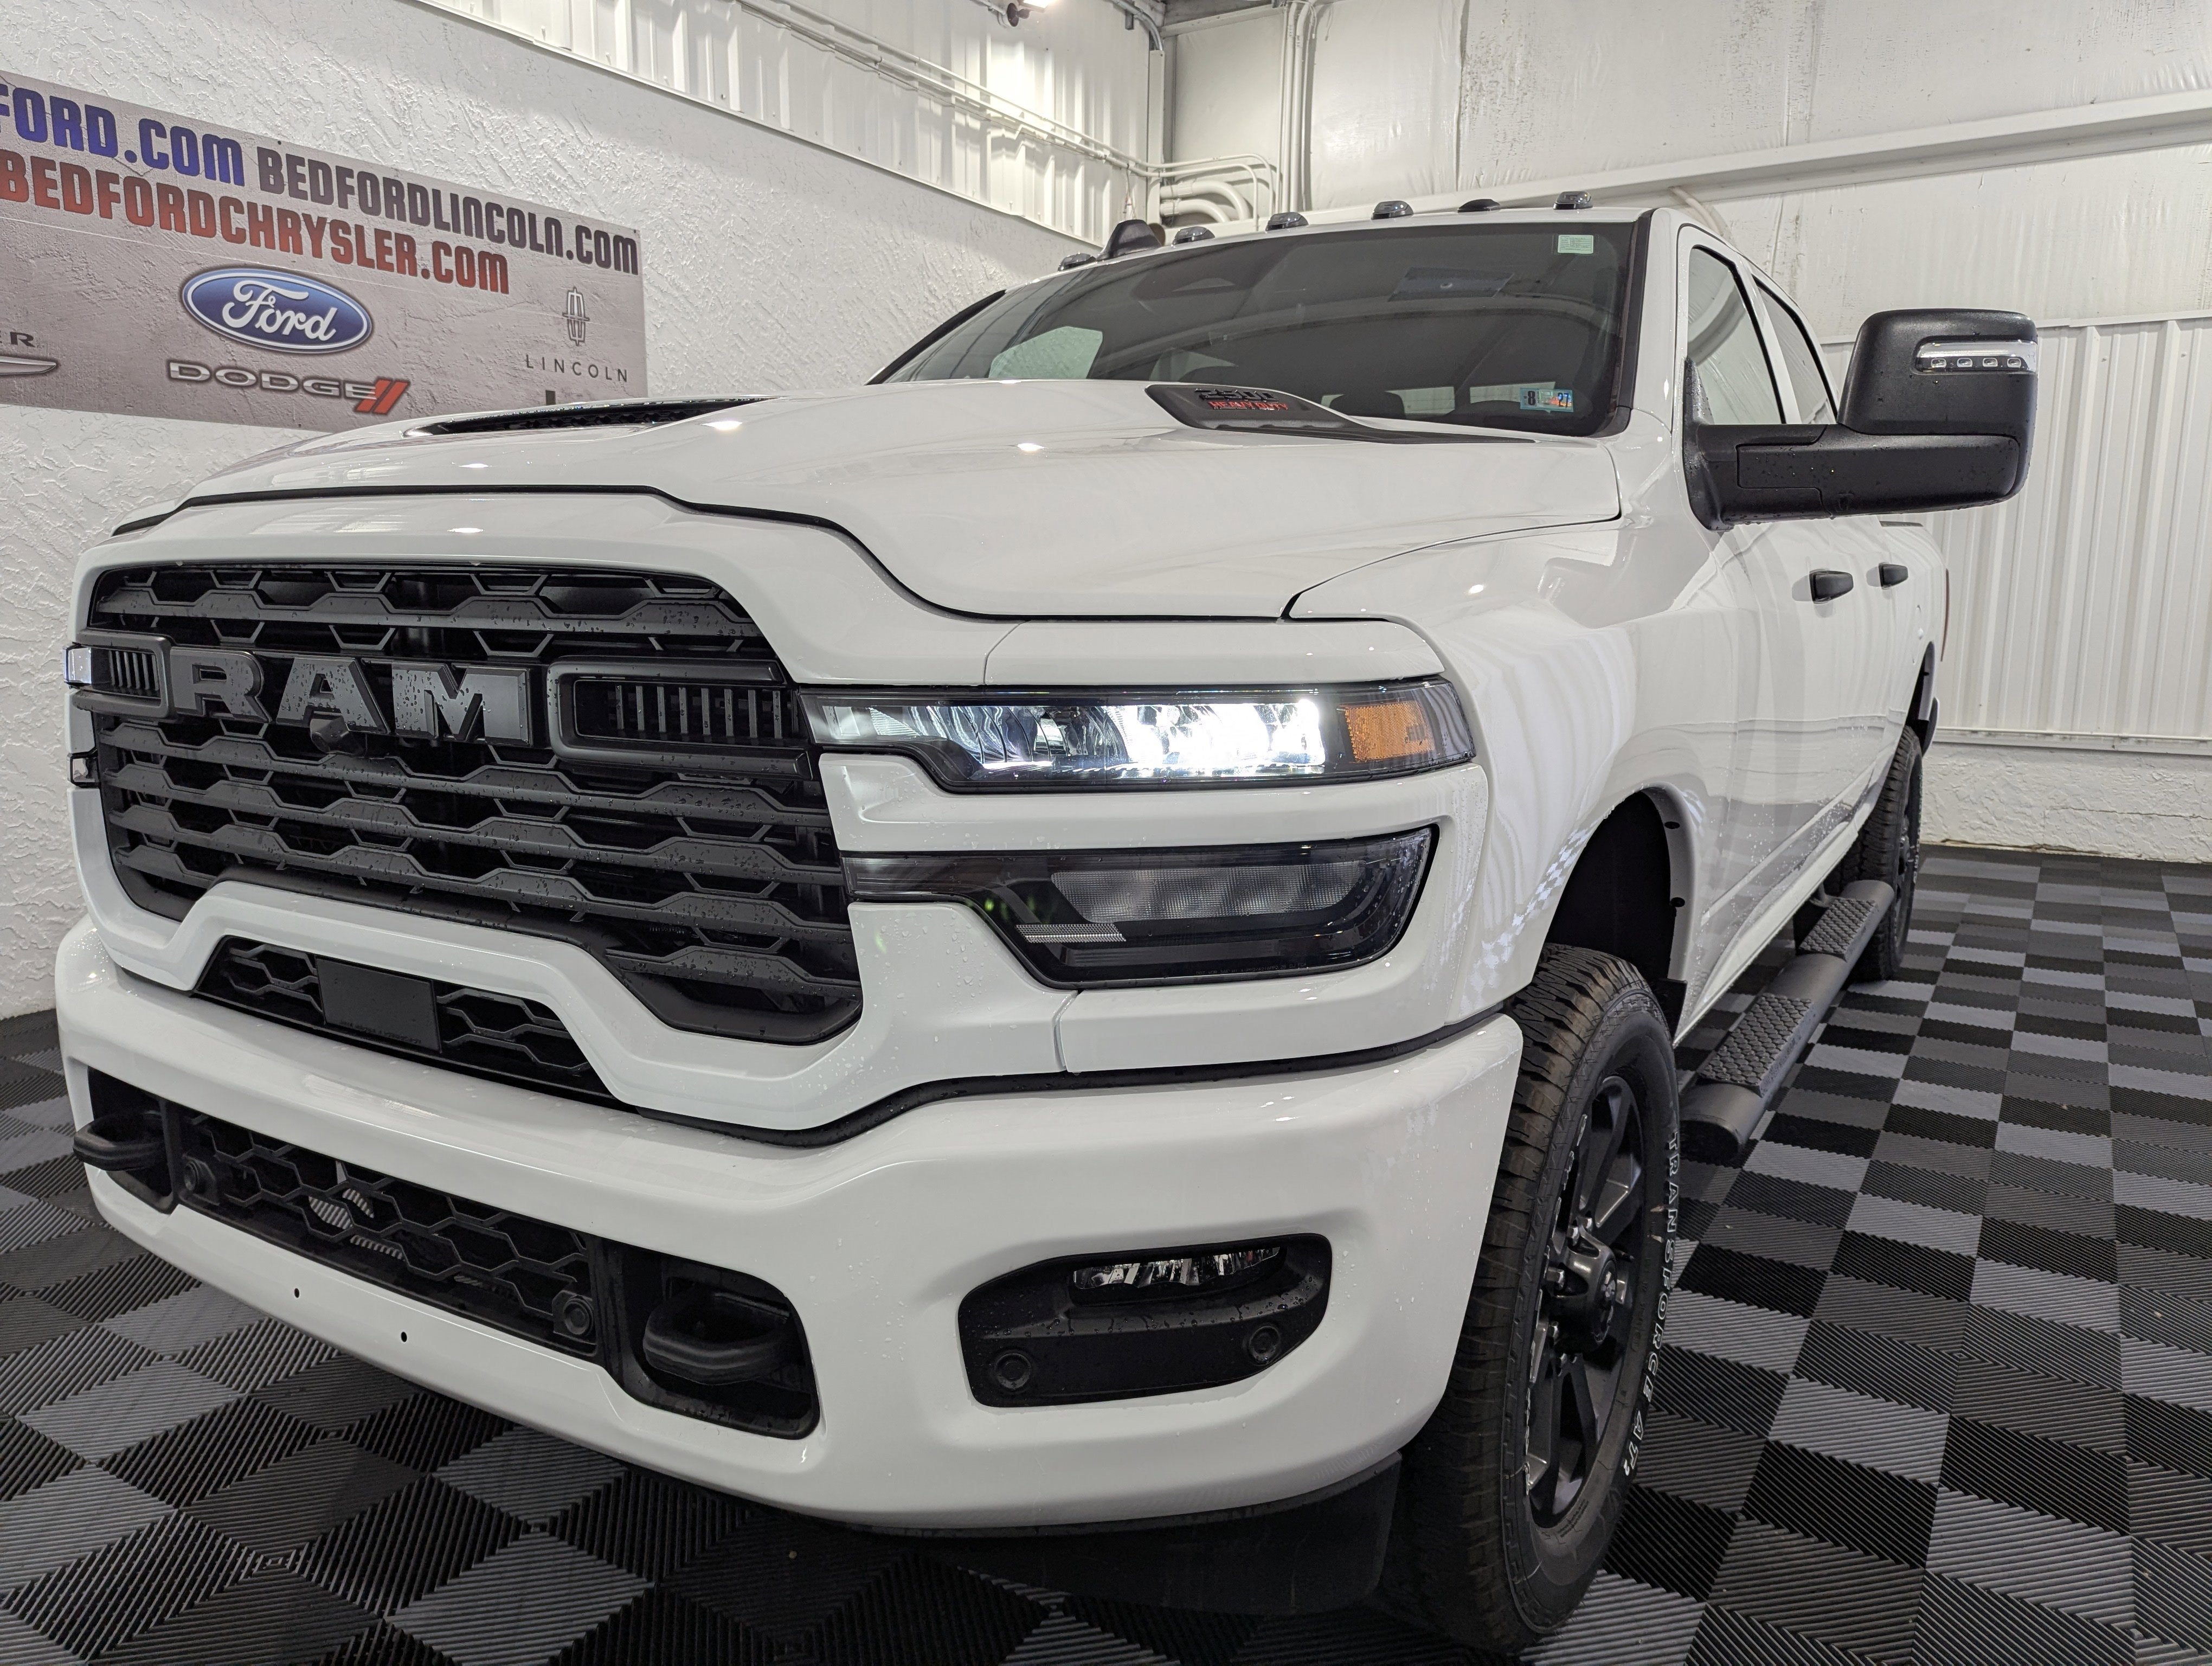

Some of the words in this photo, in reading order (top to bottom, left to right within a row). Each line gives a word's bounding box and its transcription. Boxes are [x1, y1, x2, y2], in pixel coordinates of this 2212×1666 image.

[0, 149, 510, 295] BEDFORDCHRYSLER.COM
[256, 146, 639, 275] BEDFORDLINCOLN.COM
[222, 279, 338, 342] Ford
[168, 361, 378, 401] DODGE
[525, 354, 628, 382] LINCOLN
[1557, 392, 1569, 408] 27
[170, 650, 533, 748] RAM
[1643, 1130, 1680, 1402] TRANSFORCE
